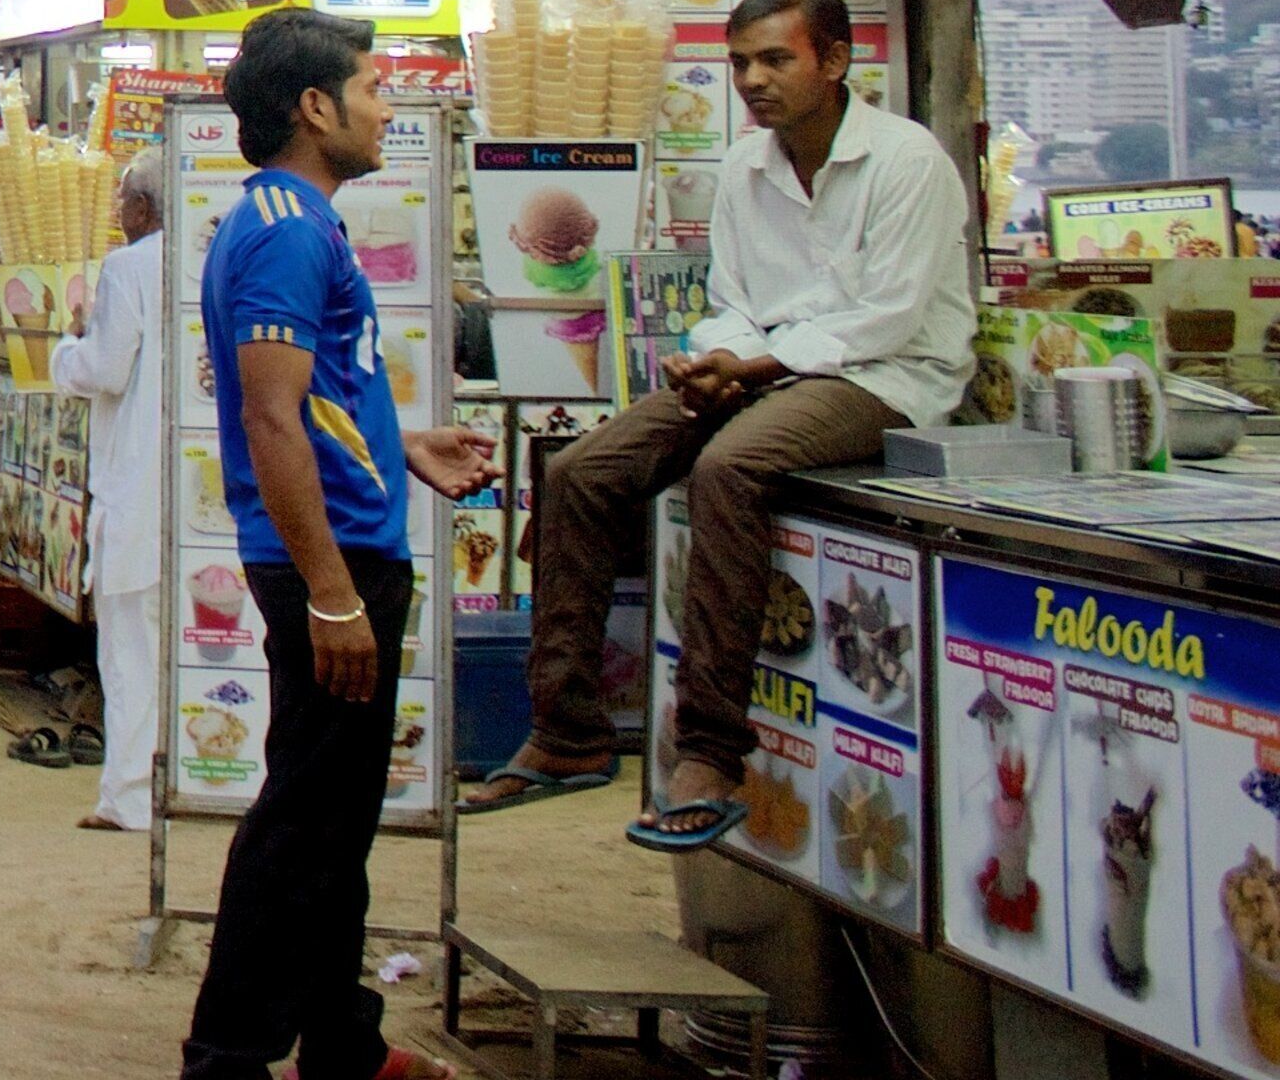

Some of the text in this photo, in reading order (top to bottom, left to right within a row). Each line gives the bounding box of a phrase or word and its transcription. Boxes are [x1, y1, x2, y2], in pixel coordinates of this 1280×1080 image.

[384, 121, 425, 135] ALL
[480, 147, 633, 165] Cone Ice Cream
[1068, 196, 1209, 215] CONE ICE-CREAMS
[824, 538, 880, 568] CHOCOLATE
[1034, 585, 1205, 680] Falooda
[946, 640, 981, 665] FRESH
[1004, 680, 1055, 709] FALOODA
[1065, 669, 1174, 714] CHOCOLATE CHIPS
[1120, 710, 1179, 742] FALOODA
